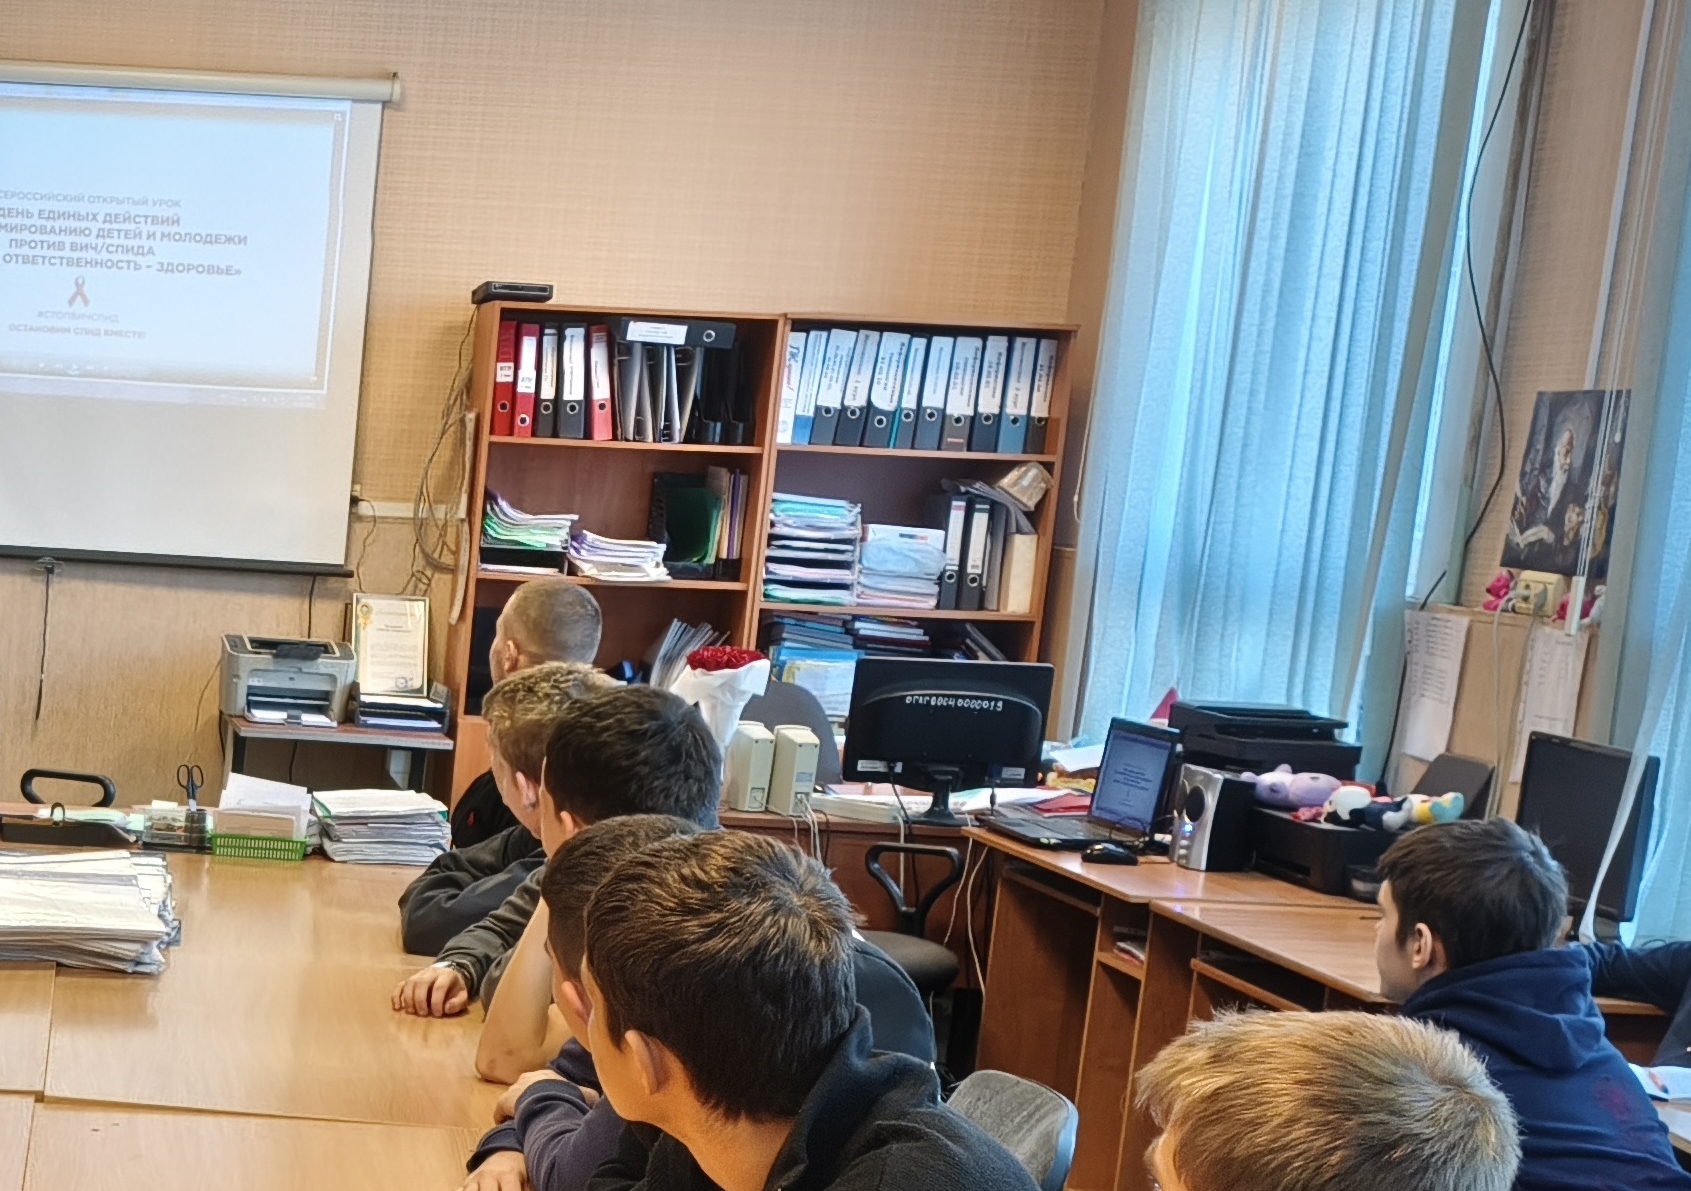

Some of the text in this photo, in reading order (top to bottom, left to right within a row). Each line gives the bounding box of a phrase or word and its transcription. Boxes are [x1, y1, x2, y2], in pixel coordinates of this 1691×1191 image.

[87, 194, 148, 207] ОТКРЫТЫЙ
[151, 198, 181, 209] УРОК
[37, 209, 99, 223] ЕДИНЫХ
[102, 210, 181, 227] ДЕЙСТВИЙ
[95, 226, 143, 241] ДЕТЕЙ
[145, 230, 157, 241] И
[160, 231, 248, 246] МОЛОДЕЖИ
[9, 238, 156, 257] ПРОТИВ ВИЧ/СПИДА
[2, 253, 142, 271] ОТВЕТСТВЕННОСТЬ
[156, 260, 242, 277] ЗДОРОВЬЕ»
